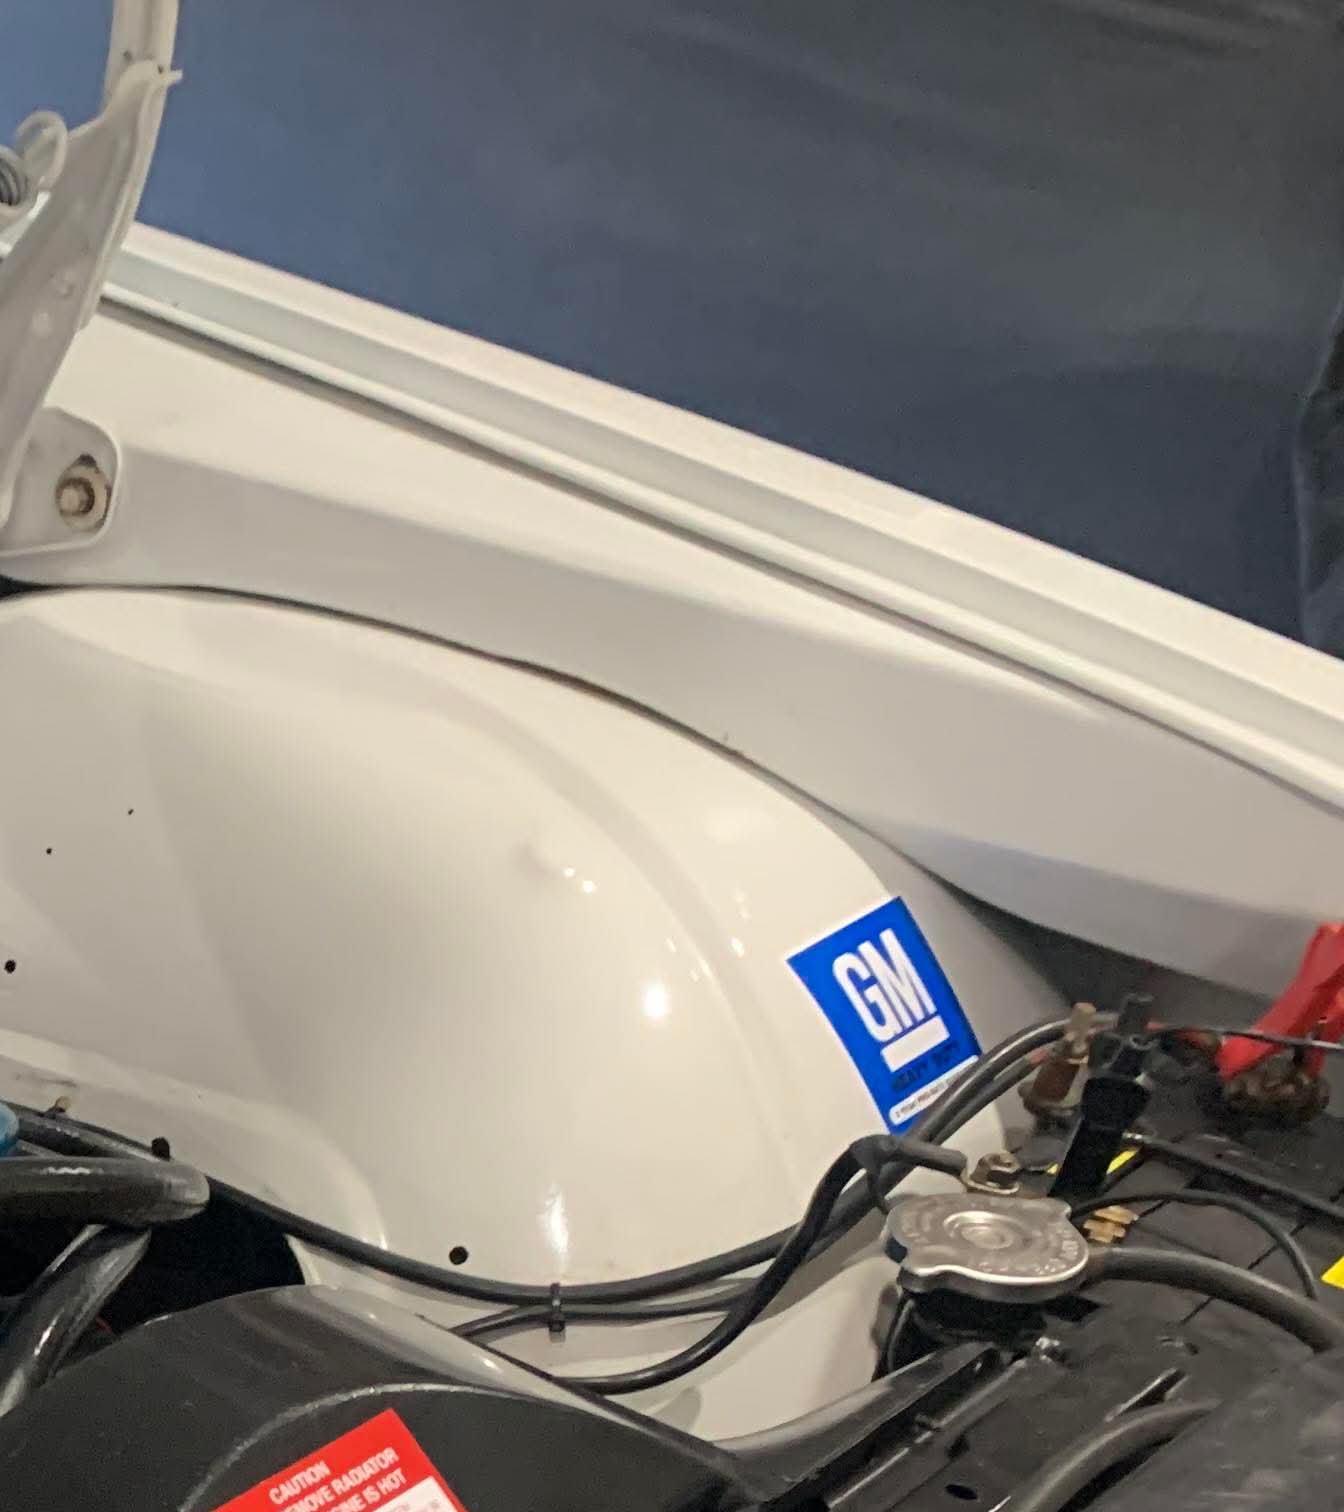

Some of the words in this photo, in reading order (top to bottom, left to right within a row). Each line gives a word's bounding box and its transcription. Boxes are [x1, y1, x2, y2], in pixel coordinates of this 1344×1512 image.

[832, 927, 937, 1044] GM
[268, 1460, 331, 1504] CAUTION
[331, 1447, 398, 1494] RADIATOR
[361, 1484, 380, 1503] IS
[376, 1469, 406, 1493] HOT
